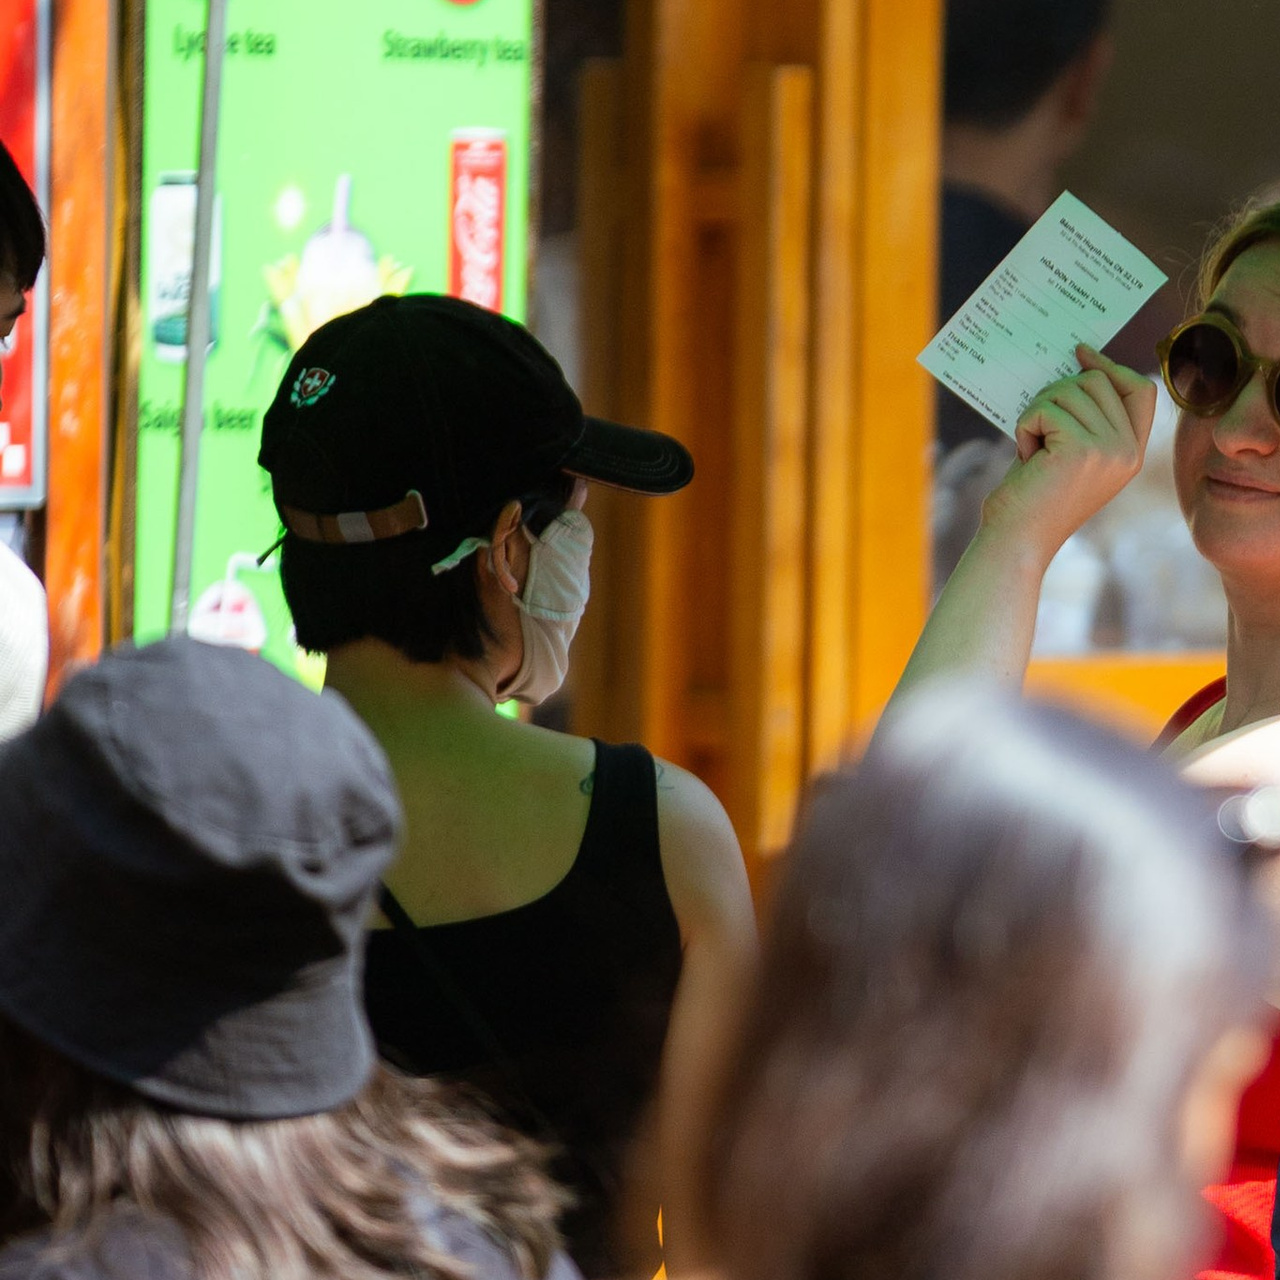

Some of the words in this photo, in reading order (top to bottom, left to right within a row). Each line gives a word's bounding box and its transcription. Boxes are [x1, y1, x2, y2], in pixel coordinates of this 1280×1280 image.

[246, 29, 276, 55] tea
[383, 29, 486, 66] Strawberry
[495, 35, 524, 61] tea
[1113, 263, 1124, 273] CN
[1068, 279, 1090, 299] THANH
[947, 330, 969, 350] THANH
[214, 400, 256, 429] beer
